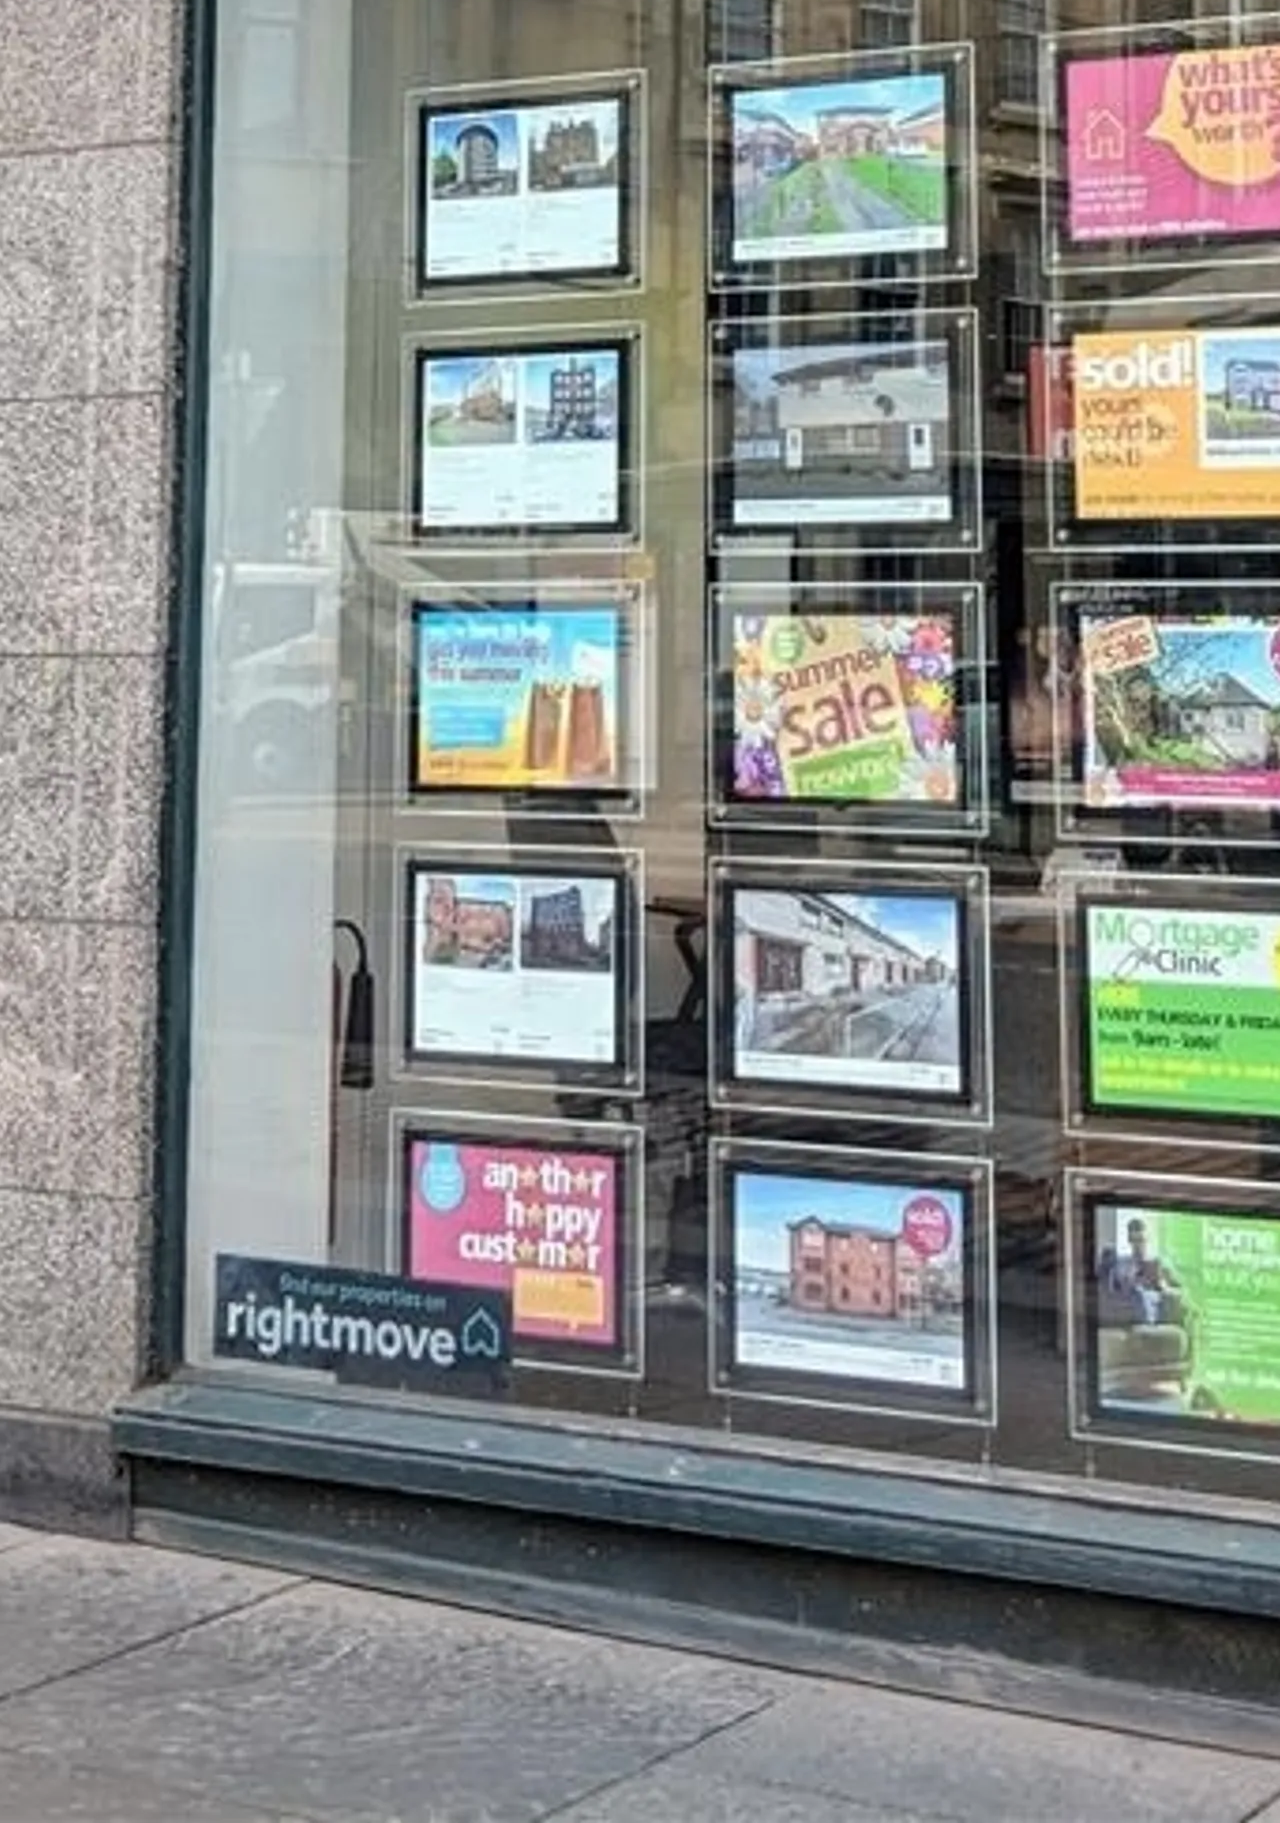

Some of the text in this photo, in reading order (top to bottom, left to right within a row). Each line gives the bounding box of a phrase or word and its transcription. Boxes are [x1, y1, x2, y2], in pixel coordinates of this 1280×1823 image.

[1082, 337, 1193, 391] sold!
[771, 645, 883, 695] summer
[781, 680, 897, 757] sale
[1096, 912, 1260, 956] Mortgage
[1154, 948, 1222, 976] Clinic
[340, 1283, 421, 1310] properties
[226, 1292, 457, 1367] rightmove
